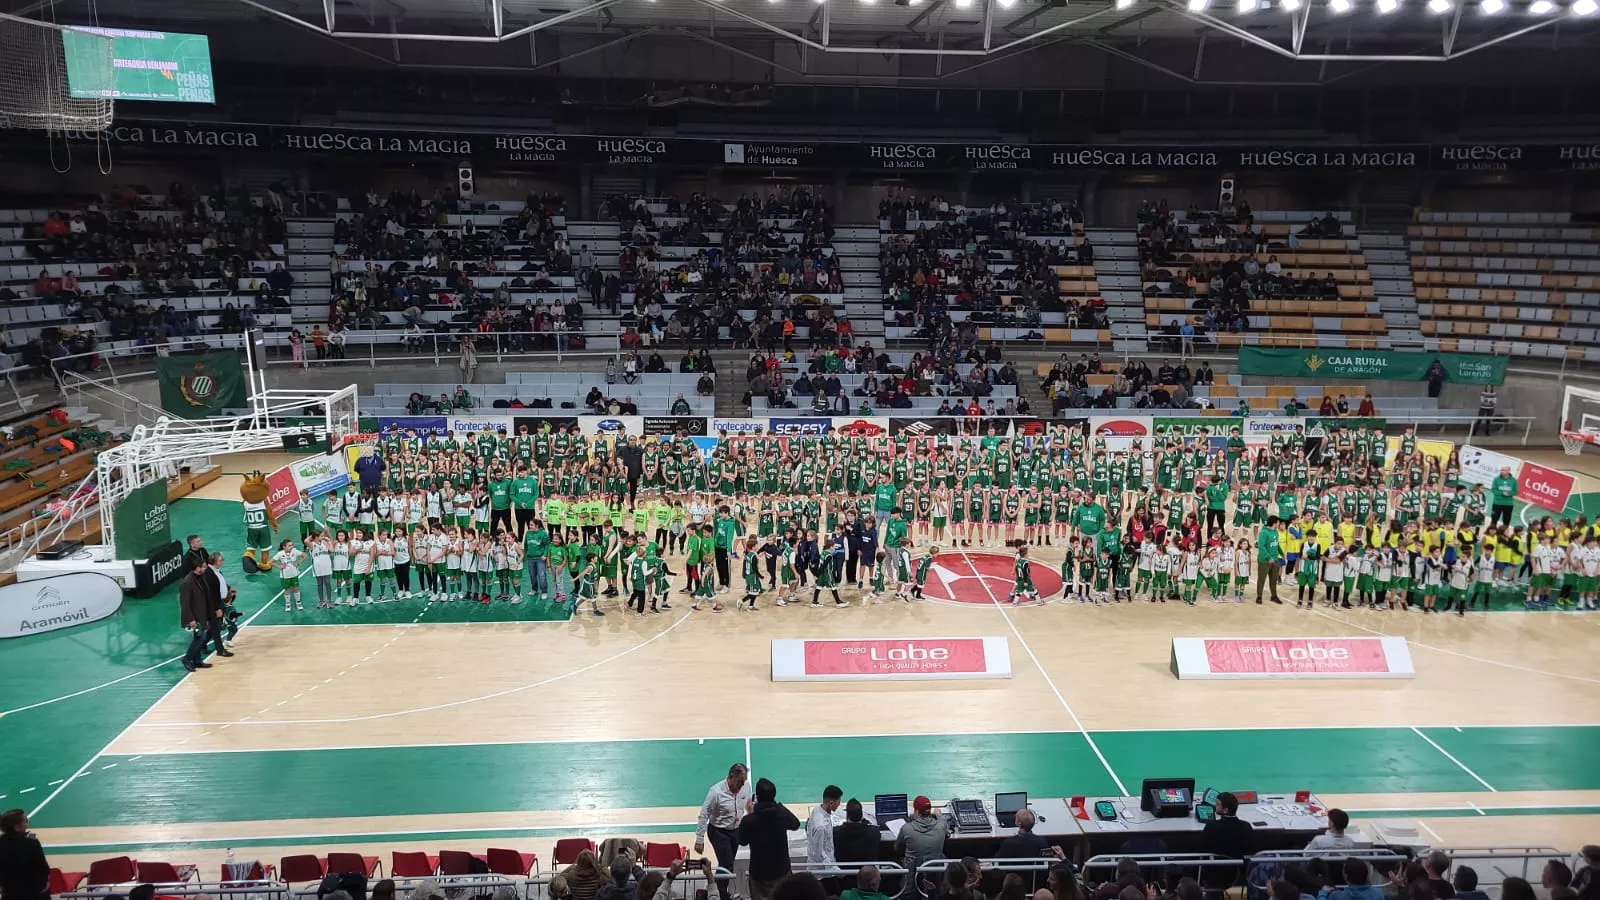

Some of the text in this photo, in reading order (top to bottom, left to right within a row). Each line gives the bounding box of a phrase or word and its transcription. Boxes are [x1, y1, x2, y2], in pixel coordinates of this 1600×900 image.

[748, 144, 814, 156] Ayuntamiento
[748, 154, 797, 165] de Huesca
[1328, 356, 1389, 367] CAJA RURAL
[1475, 362, 1492, 371] San
[1347, 365, 1382, 374] ARAGÓN
[1459, 369, 1492, 378] Lorenzo
[713, 420, 764, 431] Fontecabras
[1525, 477, 1561, 499] Lobe
[266, 485, 291, 505] Lobe
[144, 504, 167, 520] Lobe
[246, 511, 265, 523] 00
[152, 553, 182, 585] Huesca
[20, 607, 90, 632] Aramóvil
[871, 643, 948, 661] Lobe
[1270, 643, 1350, 661] Lobe
